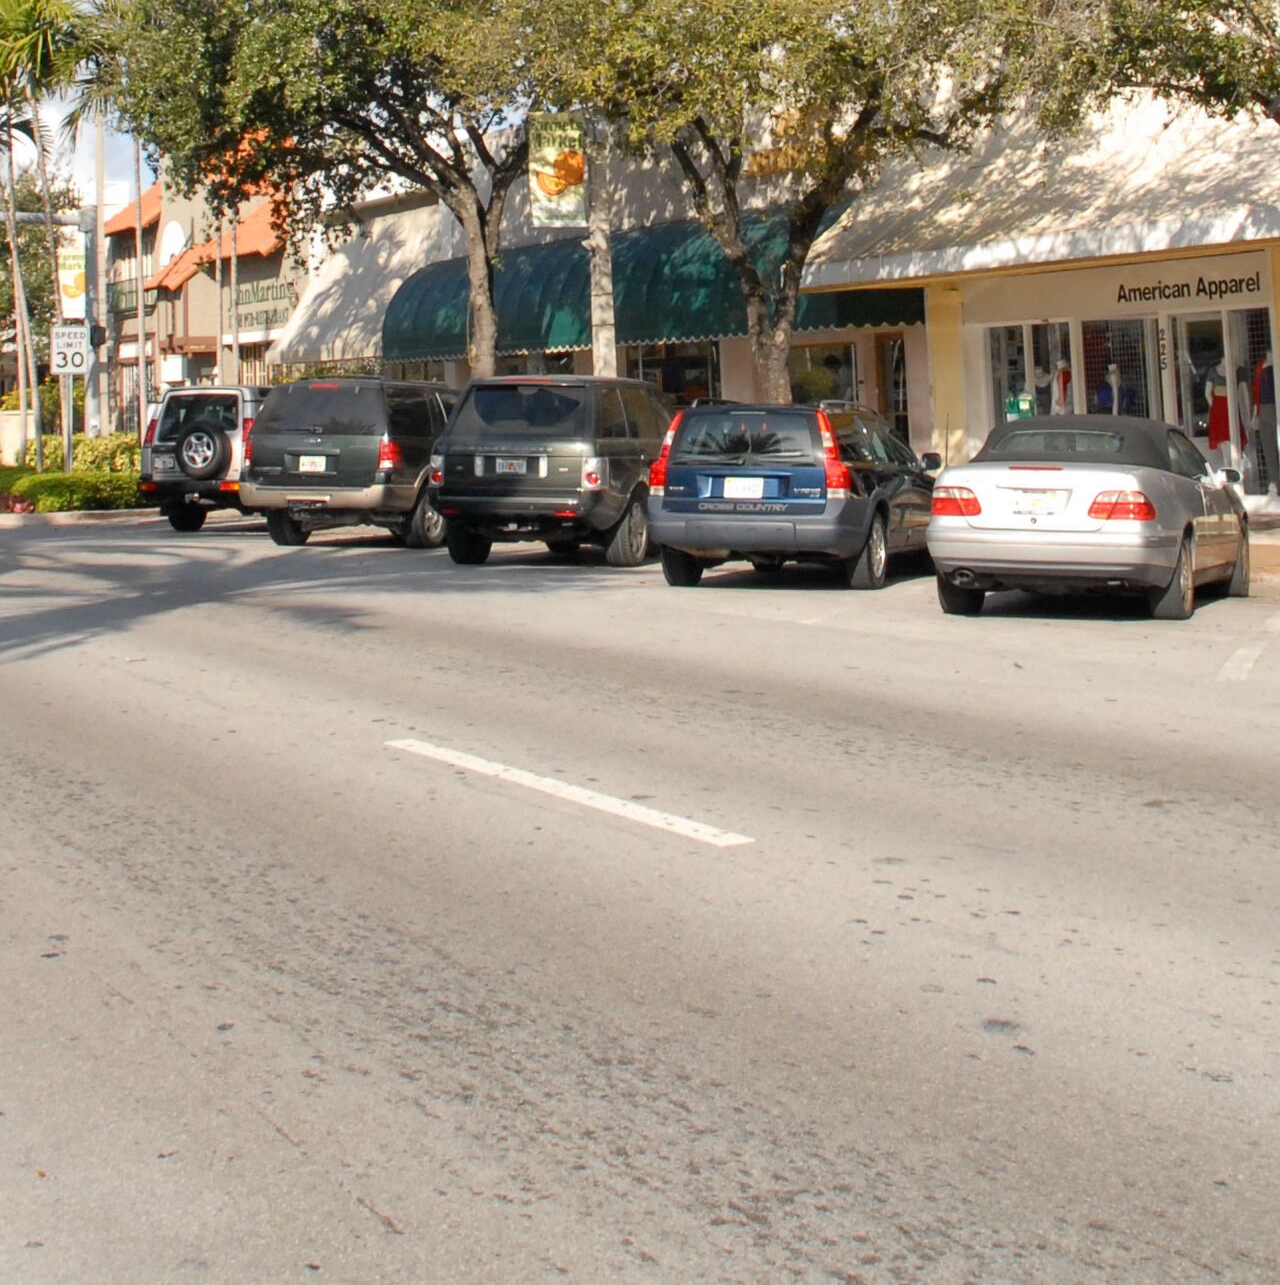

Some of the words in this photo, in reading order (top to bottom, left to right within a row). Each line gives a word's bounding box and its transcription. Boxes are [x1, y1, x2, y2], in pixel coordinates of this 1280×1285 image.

[530, 133, 583, 148] Market
[1117, 281, 1191, 303] American
[1196, 271, 1261, 300] Apparel
[55, 331, 86, 340] SPEED
[56, 341, 82, 349] LIMIT
[1159, 328, 1167, 371] 225
[56, 352, 84, 368] 30
[697, 502, 735, 511] CROSS
[736, 502, 789, 512] COUNTRY
